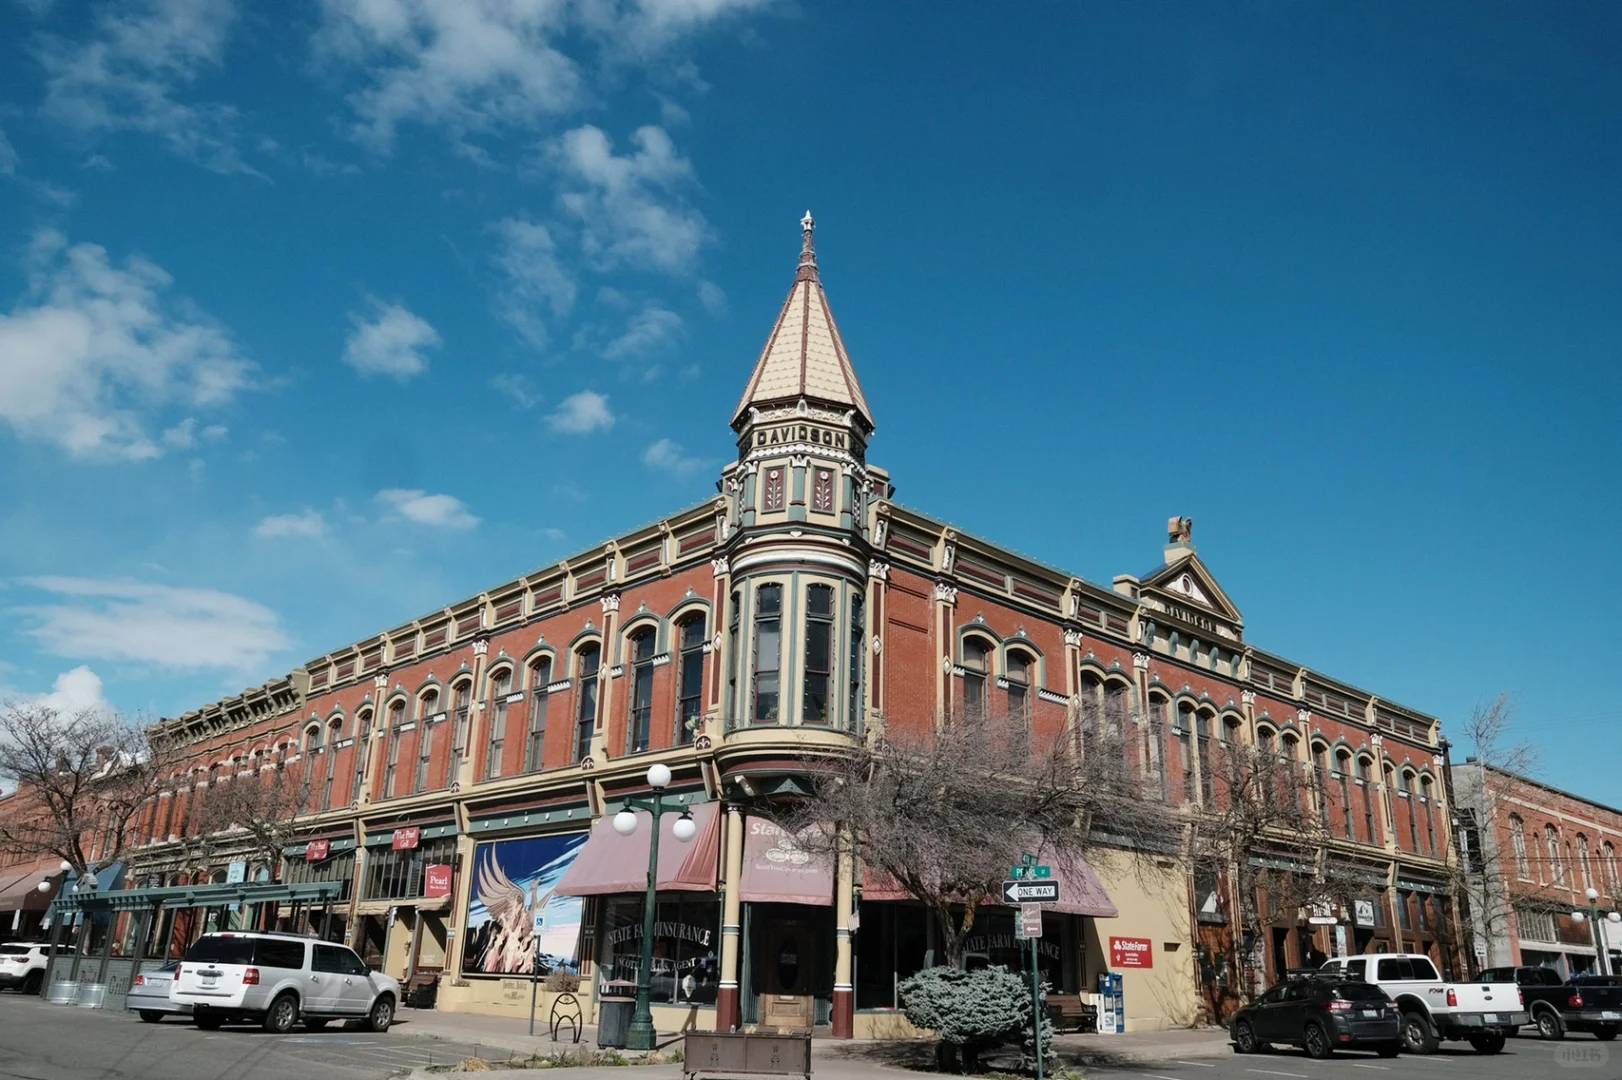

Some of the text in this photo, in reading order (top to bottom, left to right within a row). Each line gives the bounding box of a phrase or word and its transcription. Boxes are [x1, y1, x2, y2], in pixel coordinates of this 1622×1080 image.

[757, 425, 844, 448] DAVIDSON
[430, 875, 448, 885] Pearl
[1017, 887, 1053, 897] ONE WAY
[609, 925, 632, 946] STATE
[660, 921, 711, 947] INSURANCE
[672, 958, 697, 971] AGENT
